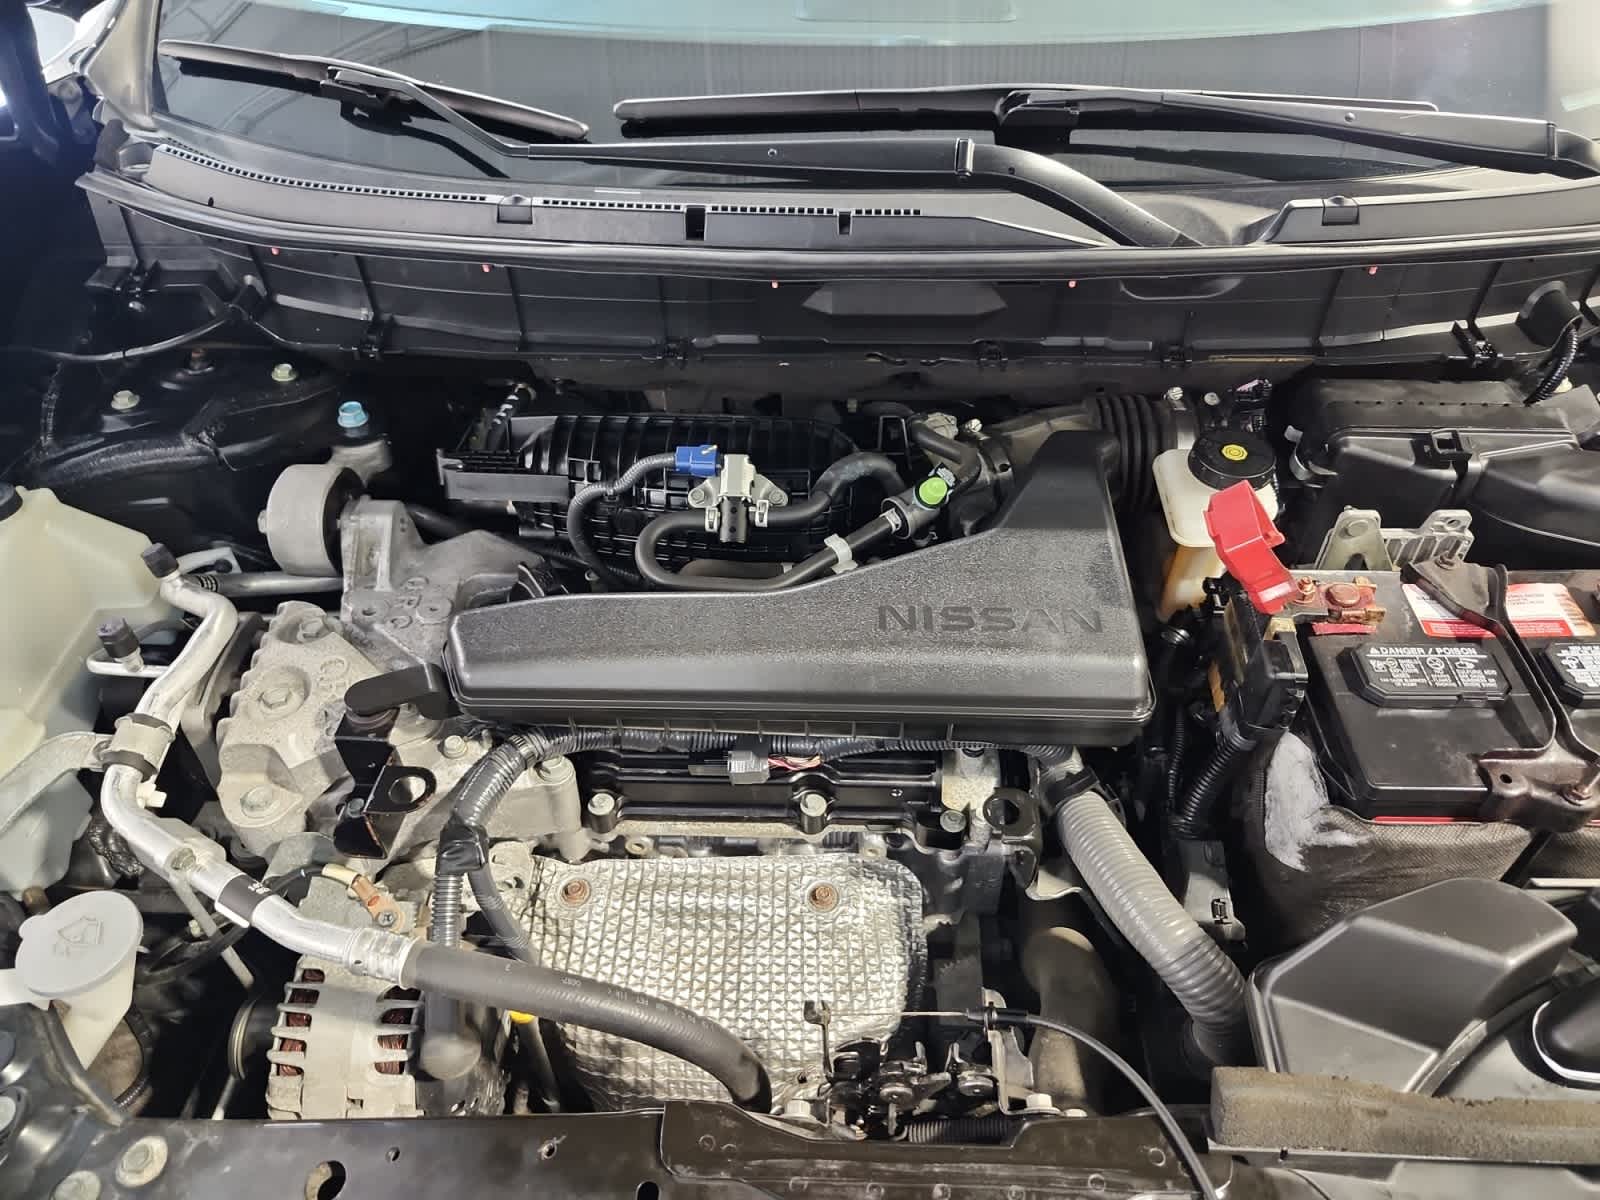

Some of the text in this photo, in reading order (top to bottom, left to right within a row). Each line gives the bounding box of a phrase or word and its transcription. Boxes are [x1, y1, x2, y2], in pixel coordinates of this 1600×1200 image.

[878, 605, 1102, 633] NISSAN
[1380, 647, 1425, 656] DANGER
[1435, 647, 1477, 656] POISON
